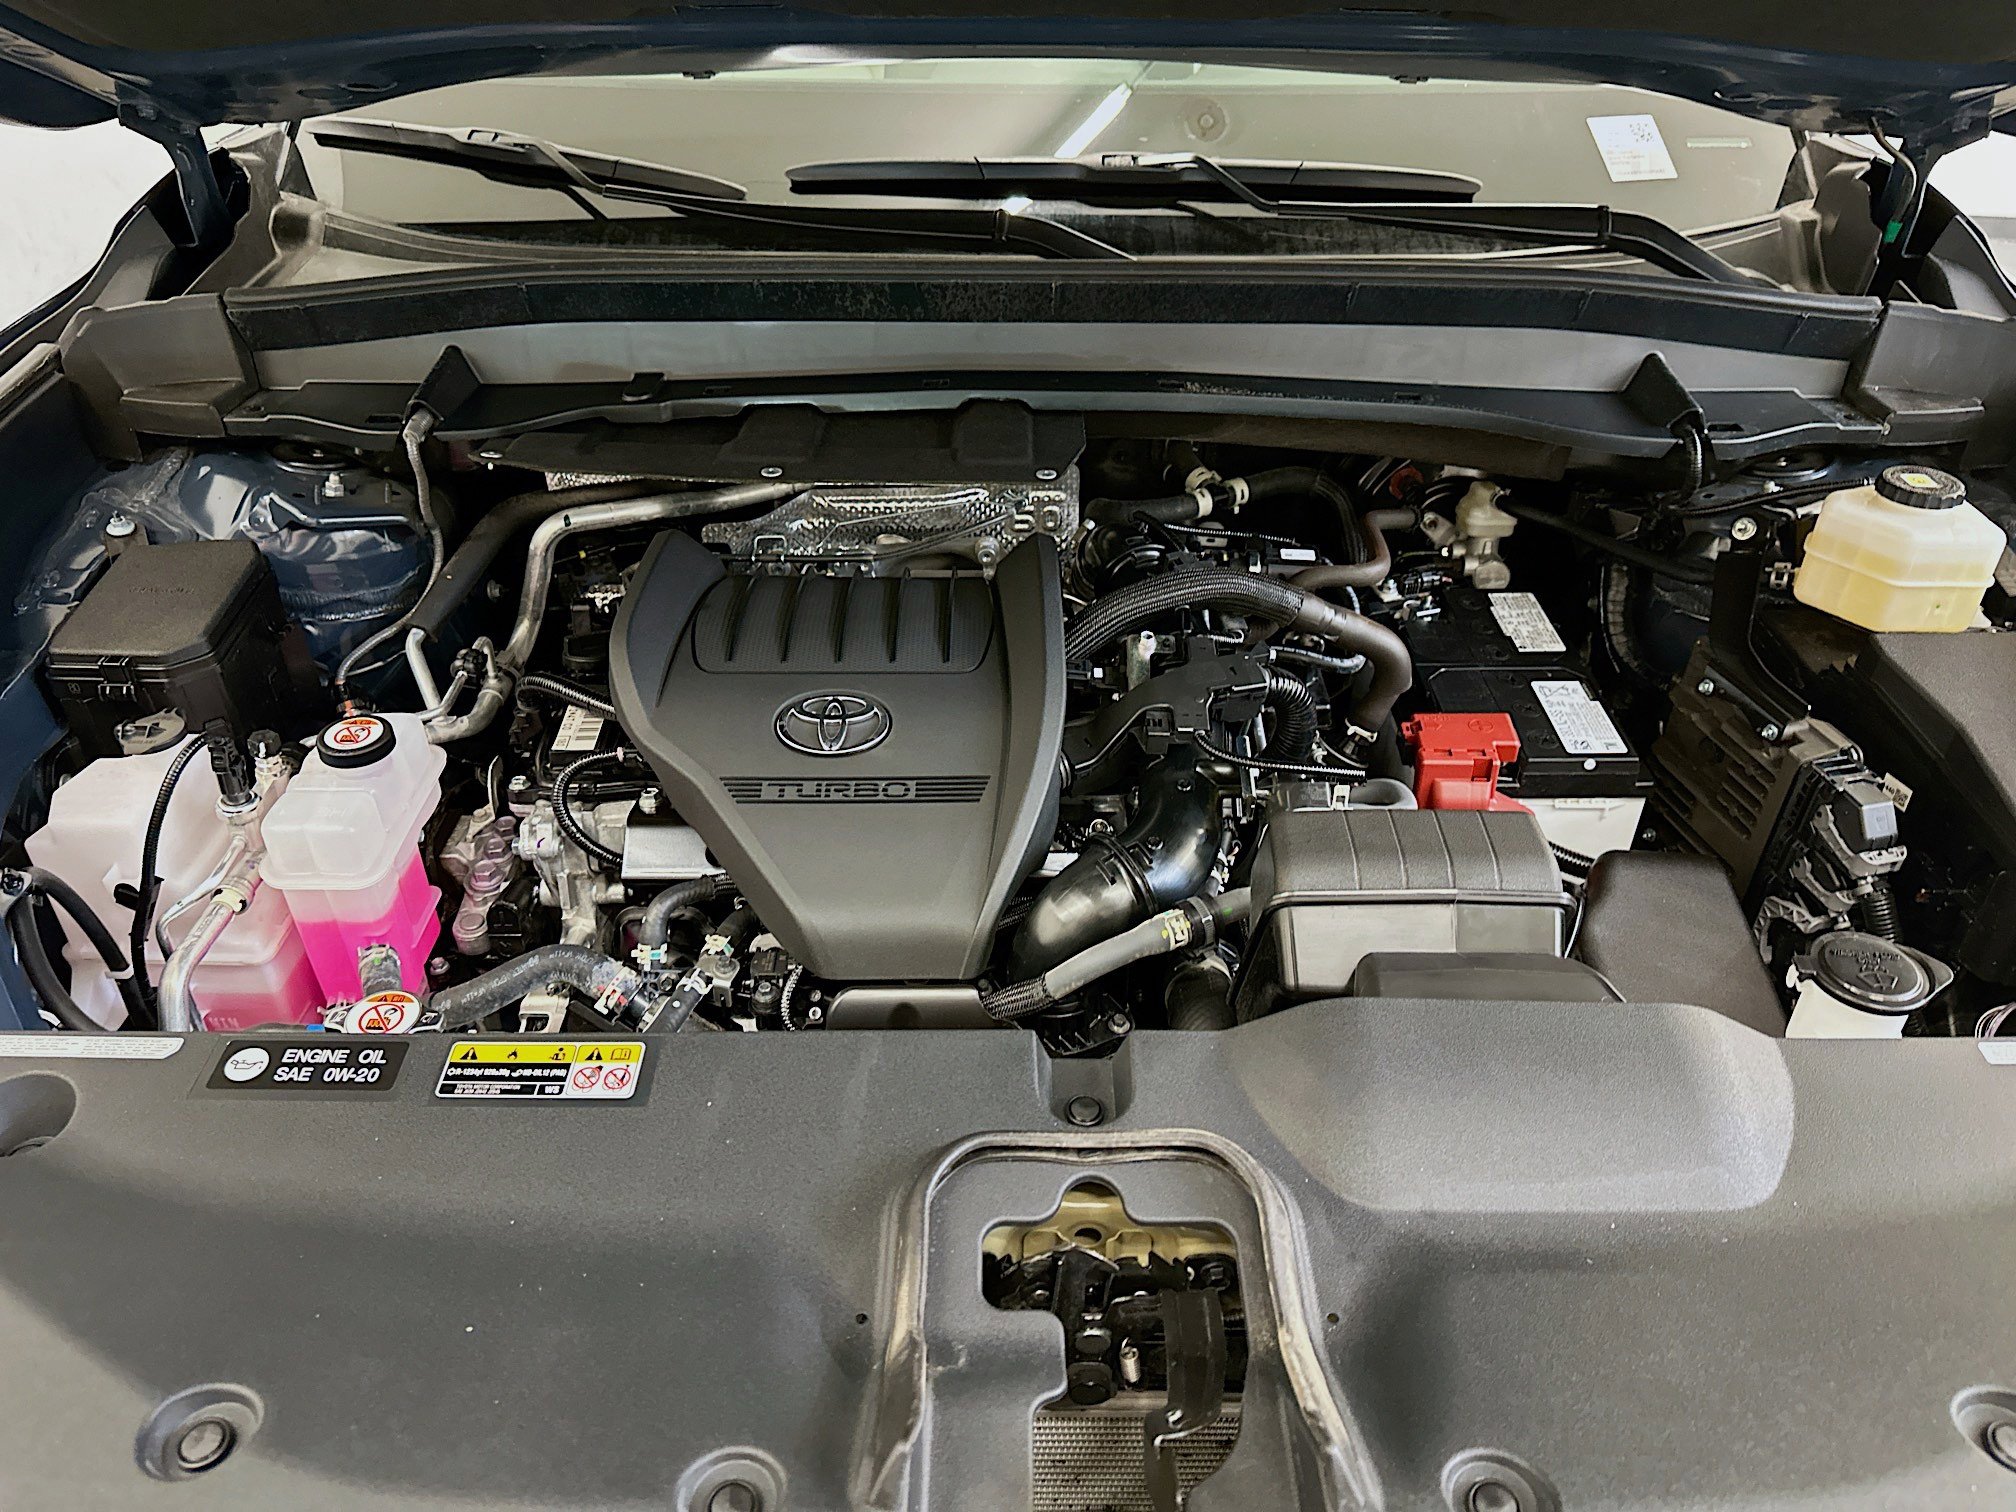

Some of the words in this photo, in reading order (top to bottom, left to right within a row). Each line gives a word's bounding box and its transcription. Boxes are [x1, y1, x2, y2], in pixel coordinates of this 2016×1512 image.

[767, 782, 911, 798] TURBO
[281, 1049, 350, 1064] ENGINE
[358, 1049, 387, 1064] OIL
[273, 1067, 314, 1082] SAE
[322, 1068, 380, 1083] 0W-20
